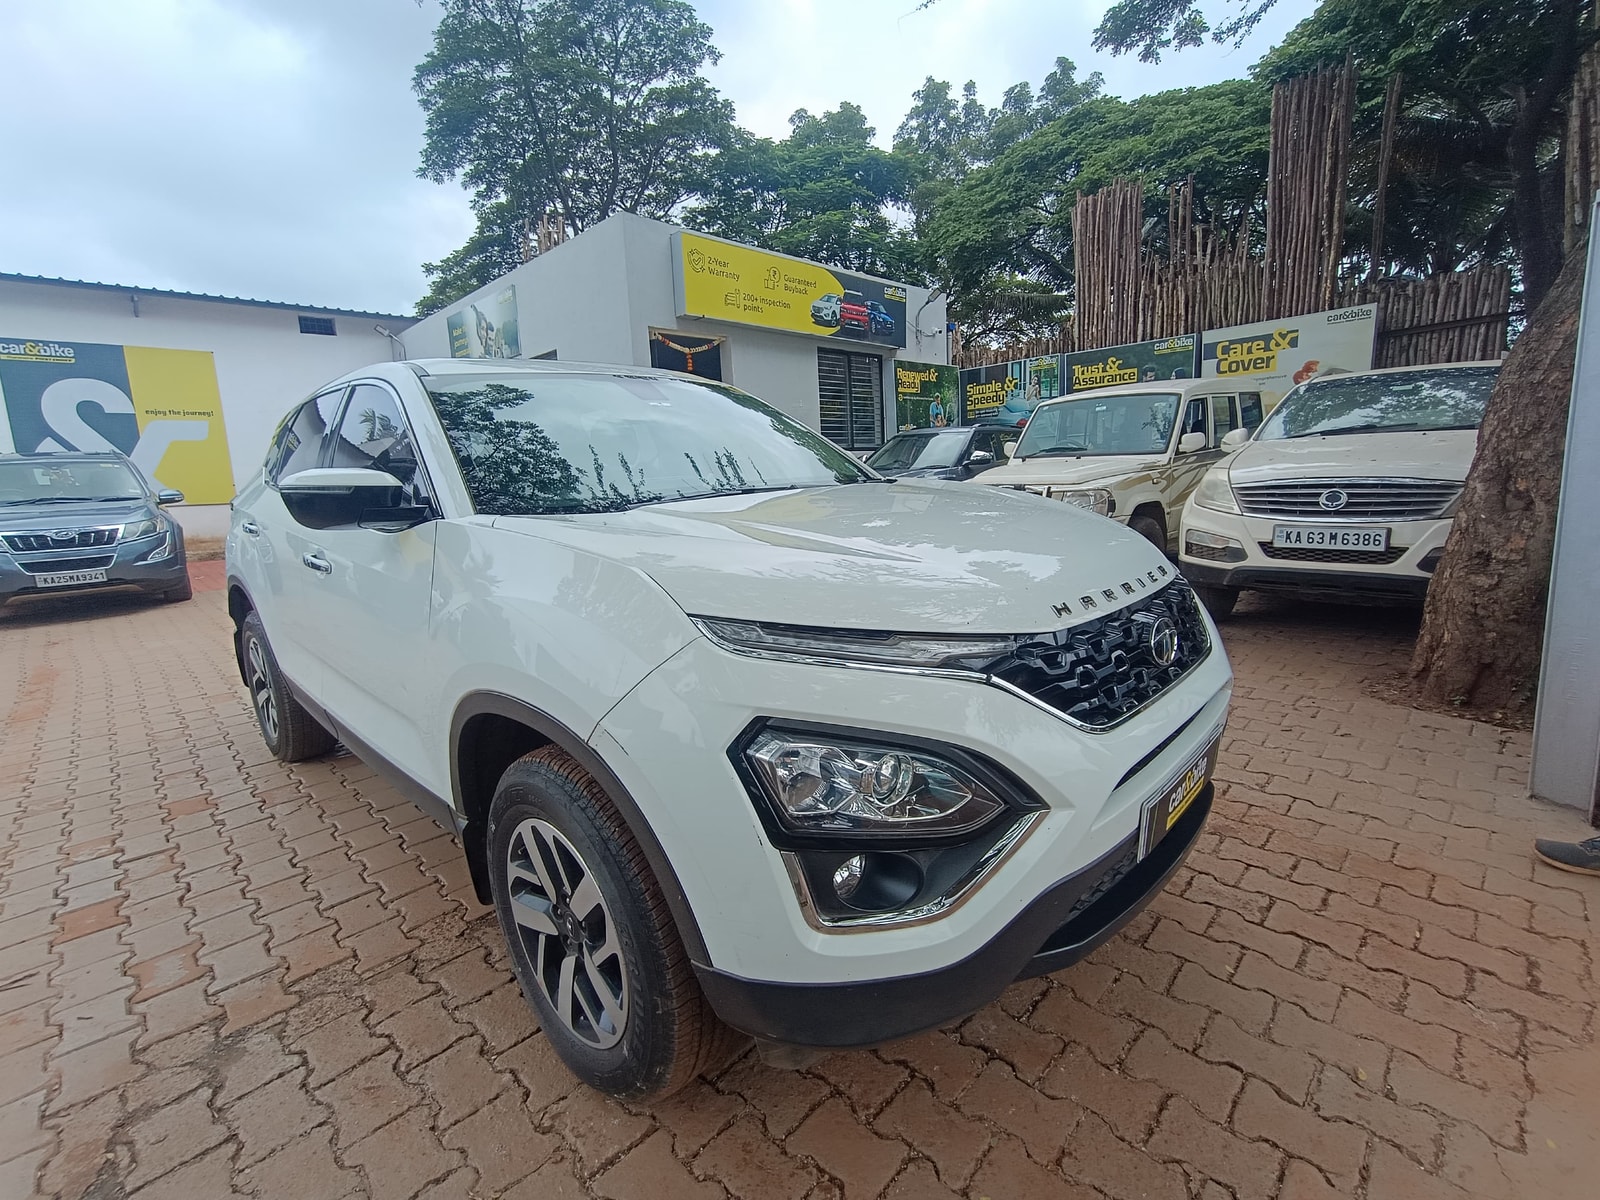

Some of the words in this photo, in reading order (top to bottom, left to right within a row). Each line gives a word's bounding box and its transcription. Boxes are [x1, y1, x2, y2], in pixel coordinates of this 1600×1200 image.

[707, 256, 730, 269] 2-Year
[707, 266, 740, 282] Warranty
[783, 274, 817, 288] Guaranteed
[784, 285, 809, 296] Buyback
[742, 293, 759, 303] 200+
[759, 292, 791, 310] inspection
[743, 303, 764, 314] points
[1326, 307, 1372, 323] car&bike
[0, 341, 75, 357] car&bike
[1154, 337, 1193, 351] car&bike
[1216, 340, 1266, 360] Care
[1269, 327, 1299, 351] &
[1072, 361, 1105, 377] Trust
[1106, 356, 1123, 373] &
[1215, 355, 1275, 375] Cover
[896, 367, 929, 382] Renewed
[929, 368, 939, 382] &
[1073, 370, 1136, 387] Assurance
[898, 380, 920, 392] Ready
[966, 379, 1002, 396] Simple
[1004, 376, 1019, 391] &
[966, 390, 1006, 408] Speedy
[145, 409, 167, 417] enjoy
[182, 409, 214, 418] journey!
[1284, 530, 1302, 544] KA
[1306, 531, 1325, 545] 63
[1328, 532, 1338, 546] M
[1341, 533, 1383, 547] 6386
[42, 572, 105, 585] KA25MA9341
[1049, 564, 1168, 619] HARRIER
[1168, 756, 1208, 813] car&bike
